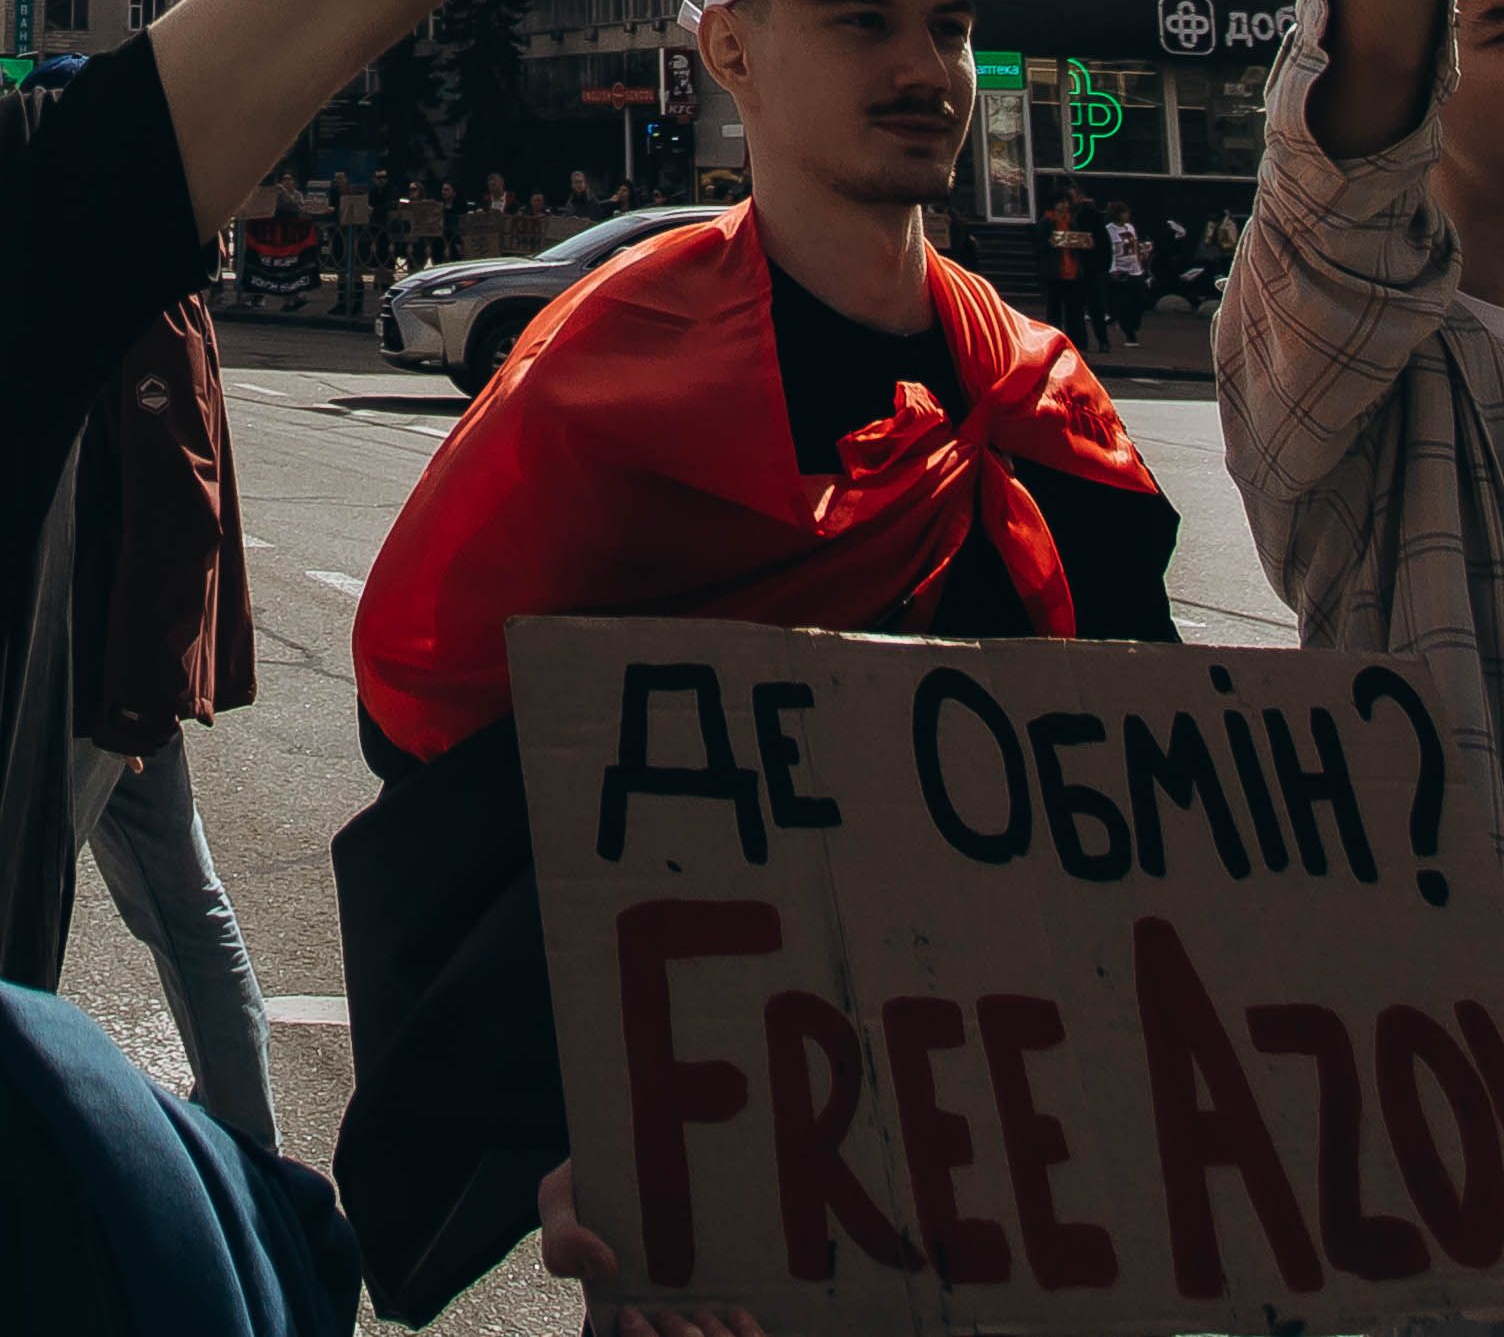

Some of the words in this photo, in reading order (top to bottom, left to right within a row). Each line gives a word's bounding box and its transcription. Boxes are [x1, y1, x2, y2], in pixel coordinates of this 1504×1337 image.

[668, 104, 696, 115] KFC
[595, 662, 842, 866] ДЕ
[616, 898, 1120, 1291] FREE
